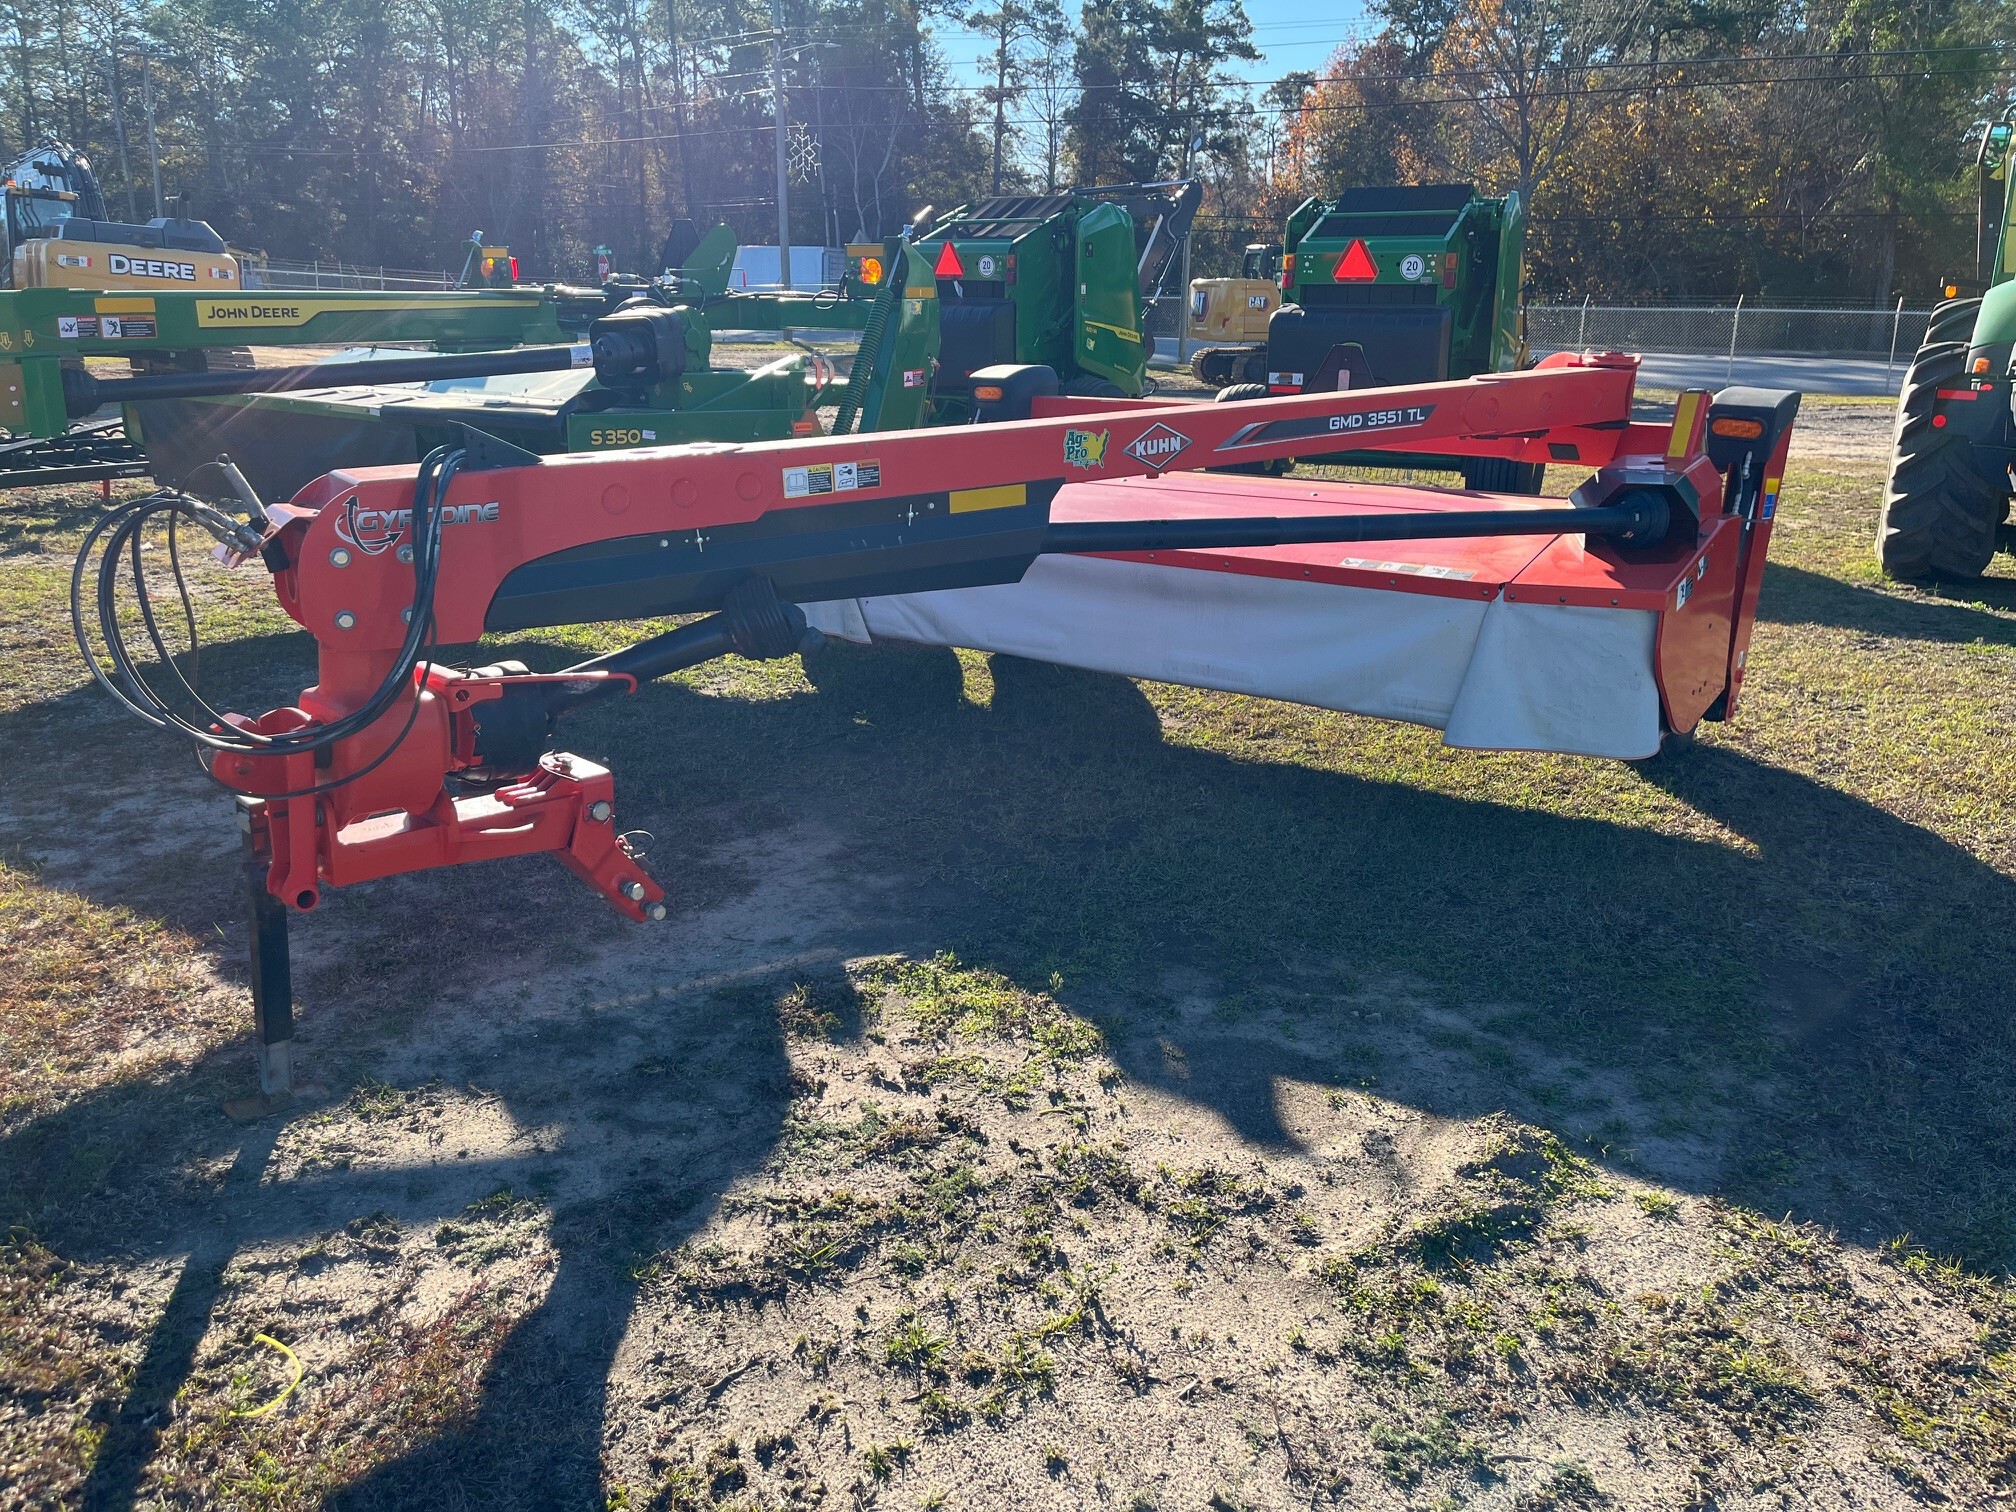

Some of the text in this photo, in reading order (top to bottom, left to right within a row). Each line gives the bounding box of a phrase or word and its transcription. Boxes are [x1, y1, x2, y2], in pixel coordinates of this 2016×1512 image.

[109, 253, 195, 281] DEERE
[982, 260, 991, 270] 20
[1406, 260, 1418, 271] 20
[1248, 296, 1266, 309] CAT
[208, 305, 300, 319] JOHN DEERE
[1329, 408, 1425, 430] GMD 3551 TL
[590, 428, 641, 446] S 350
[1066, 430, 1088, 448] Ag-
[1066, 446, 1088, 460] Pro
[1135, 436, 1181, 457] KUHN
